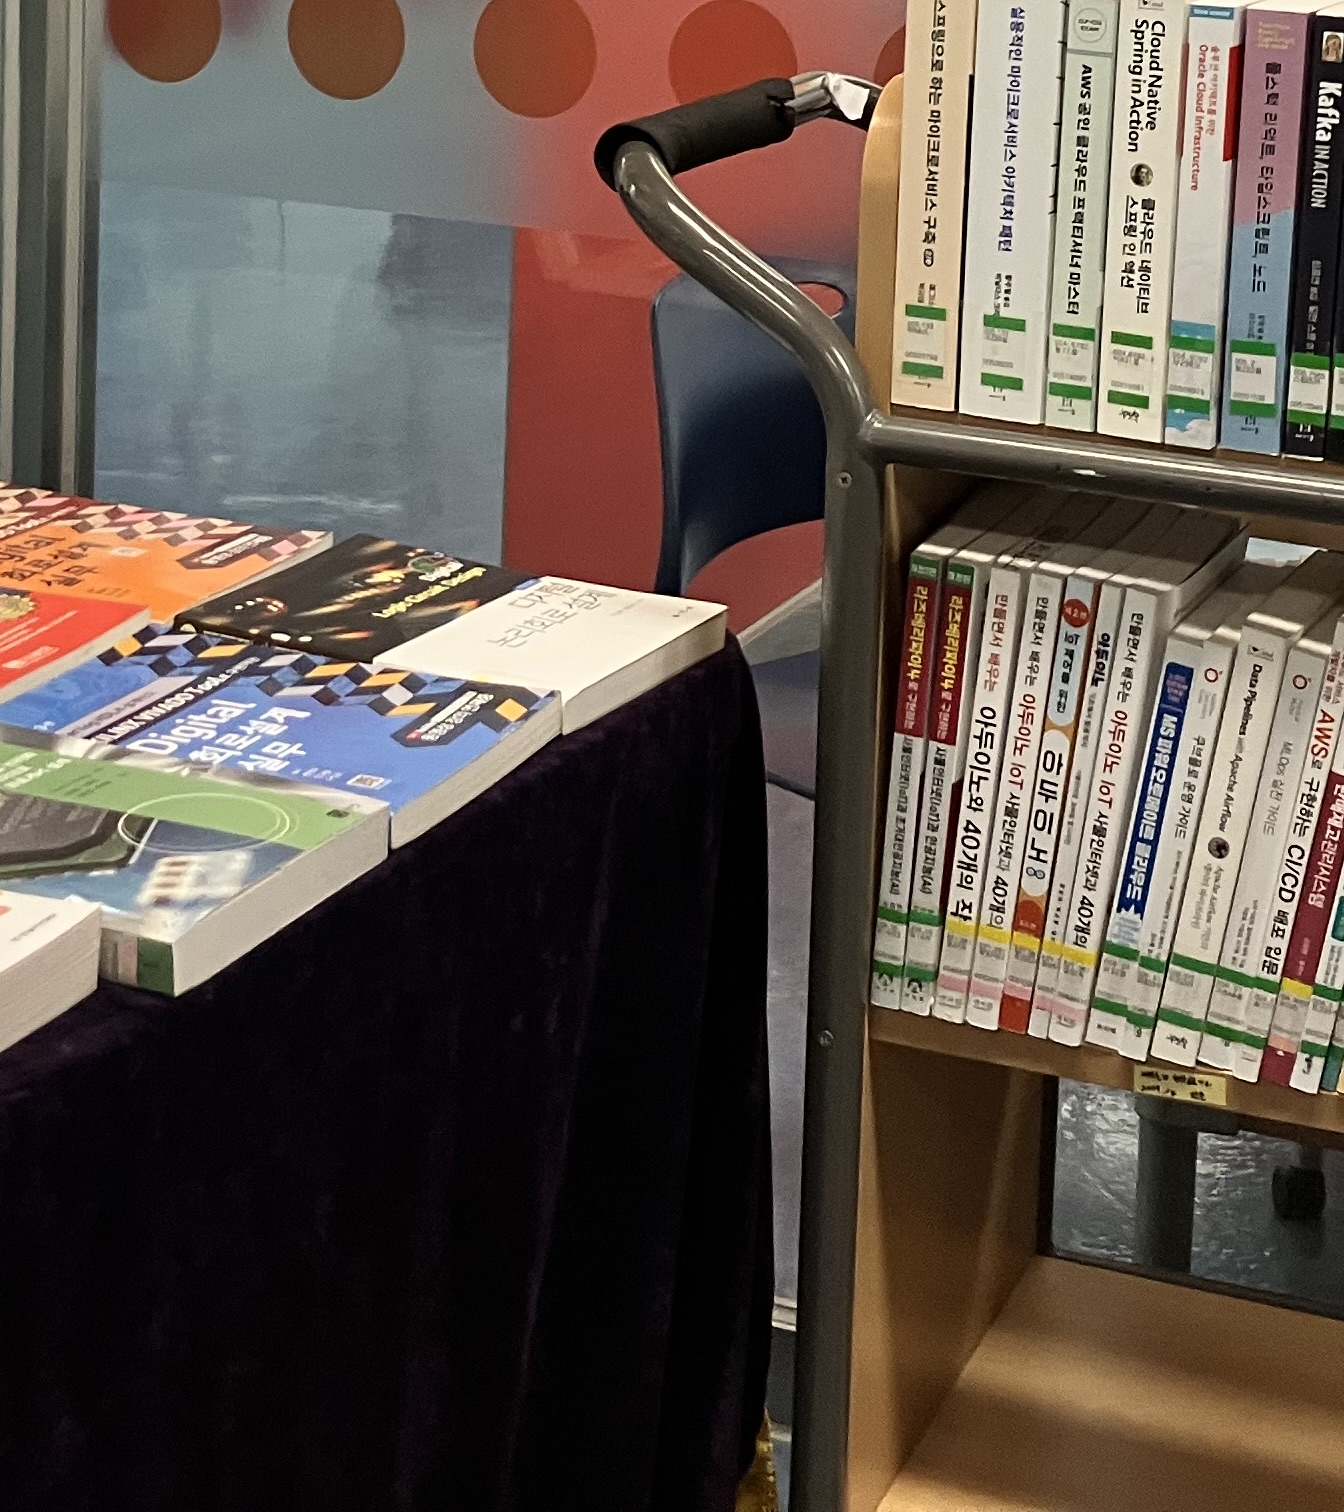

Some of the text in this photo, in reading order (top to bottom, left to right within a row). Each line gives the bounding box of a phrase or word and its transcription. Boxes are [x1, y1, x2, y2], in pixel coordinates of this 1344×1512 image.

[927, 76, 944, 106] 하는
[998, 6, 1025, 220] 실용적인 마이크로서비스 아키텍처
[1126, 18, 1150, 153] Spring in Action
[1144, 19, 1166, 131] Cloud Native
[1188, 44, 1209, 191] Oracle Cloud Infrastructure
[922, 108, 942, 212] 마이크로서비스
[1065, 63, 1094, 315] AWS 클라우드 프랙티셔너 마스터
[1251, 61, 1281, 293] 풀스택 노드
[1308, 80, 1343, 209] Kafka ACTION
[921, 215, 937, 245] 구축
[1121, 194, 1140, 256] 스프링 인
[1135, 197, 1155, 314] 클라우드 네이티브
[508, 581, 578, 610] 디지털
[1088, 631, 1113, 688] 아두이노
[126, 699, 257, 755] Digital
[190, 707, 311, 764] 회로설계
[238, 740, 306, 772] 실무
[952, 651, 1001, 890] 배우는 아두이노와 40개의
[1215, 662, 1263, 833] Data Pipelines Apache Airflow
[986, 649, 1043, 930] 배우는 아두이노 IoT 사물인터넷과 40개의
[1069, 664, 1136, 949] 배우는 아두이노 IoT 사물인터넷과 40개의
[1172, 805, 1193, 841] 가이드
[1261, 802, 1281, 837] 가이드
[1259, 774, 1322, 977] 구현하는 CI/CD 배포 입문
